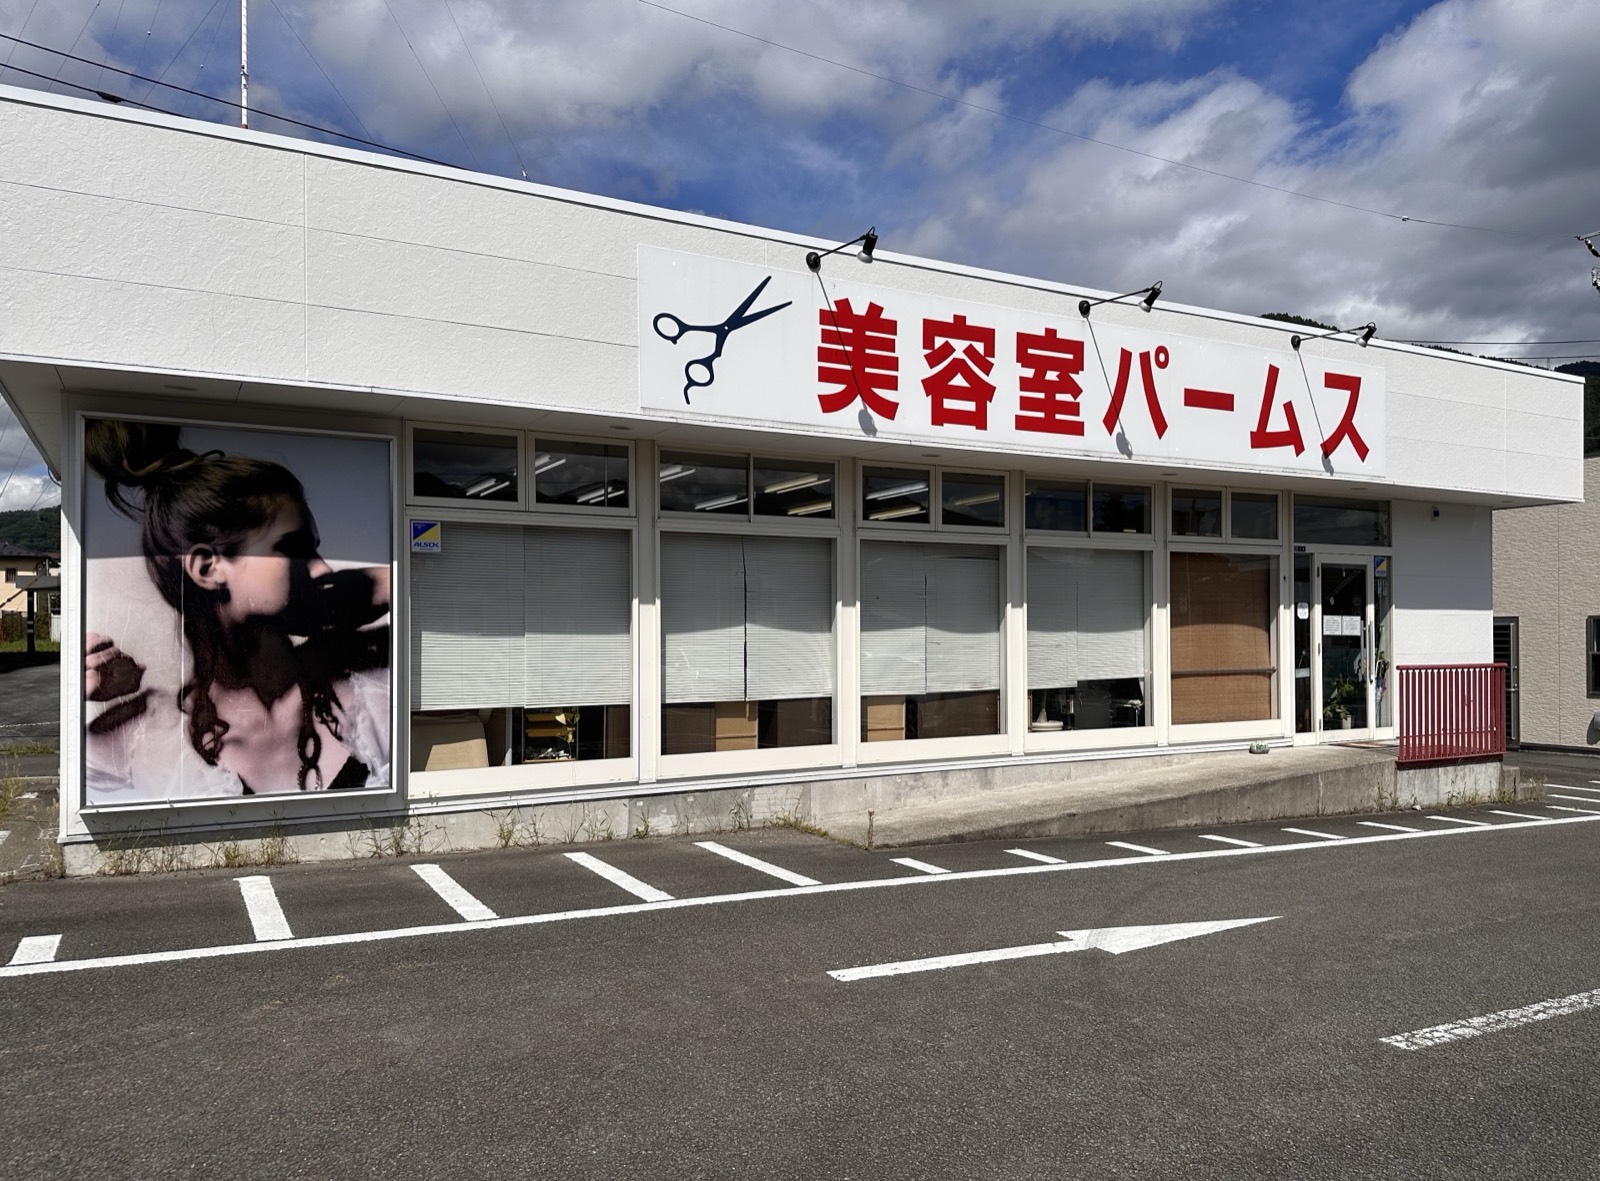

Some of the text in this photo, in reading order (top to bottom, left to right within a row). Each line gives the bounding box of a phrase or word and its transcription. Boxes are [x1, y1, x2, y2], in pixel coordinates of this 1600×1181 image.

[817, 298, 1369, 461] 美容室パームス
